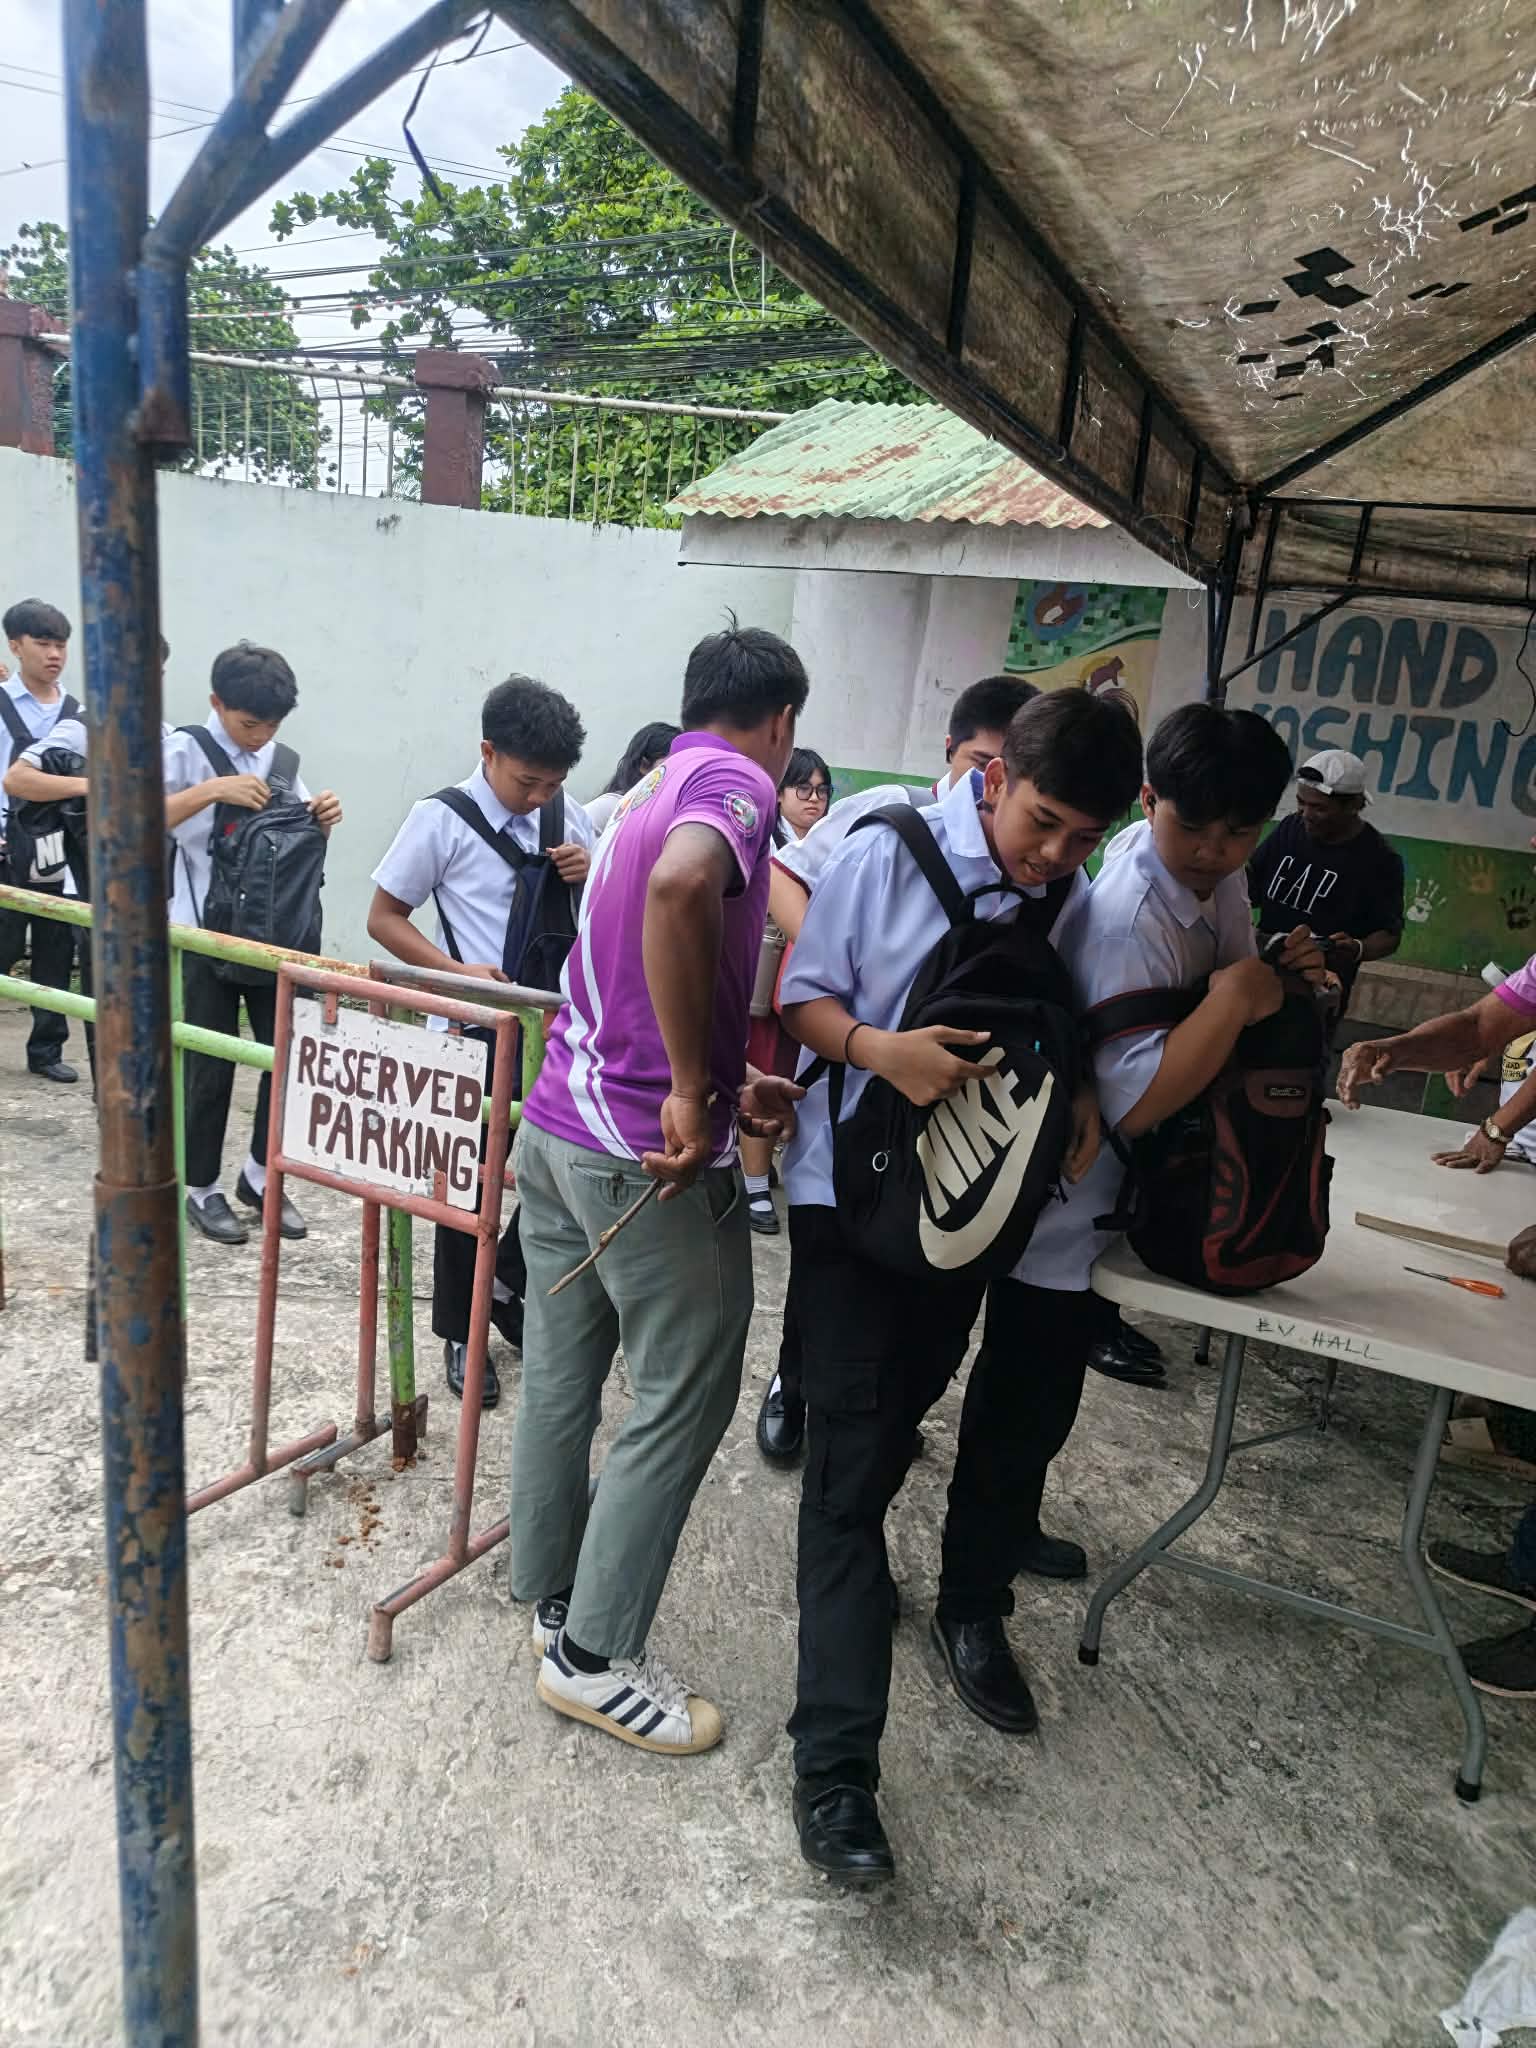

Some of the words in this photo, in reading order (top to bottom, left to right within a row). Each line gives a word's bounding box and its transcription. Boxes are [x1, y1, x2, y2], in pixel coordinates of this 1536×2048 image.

[1256, 608, 1498, 708] HAND
[1251, 703, 1536, 818] ASHIN
[35, 830, 65, 870] NI
[1266, 855, 1339, 915] GAP
[297, 1035, 482, 1123] RESERVED
[307, 1092, 478, 1192] PARKING
[916, 1046, 1037, 1220] NIKE
[1312, 1329, 1384, 1361] HALL
